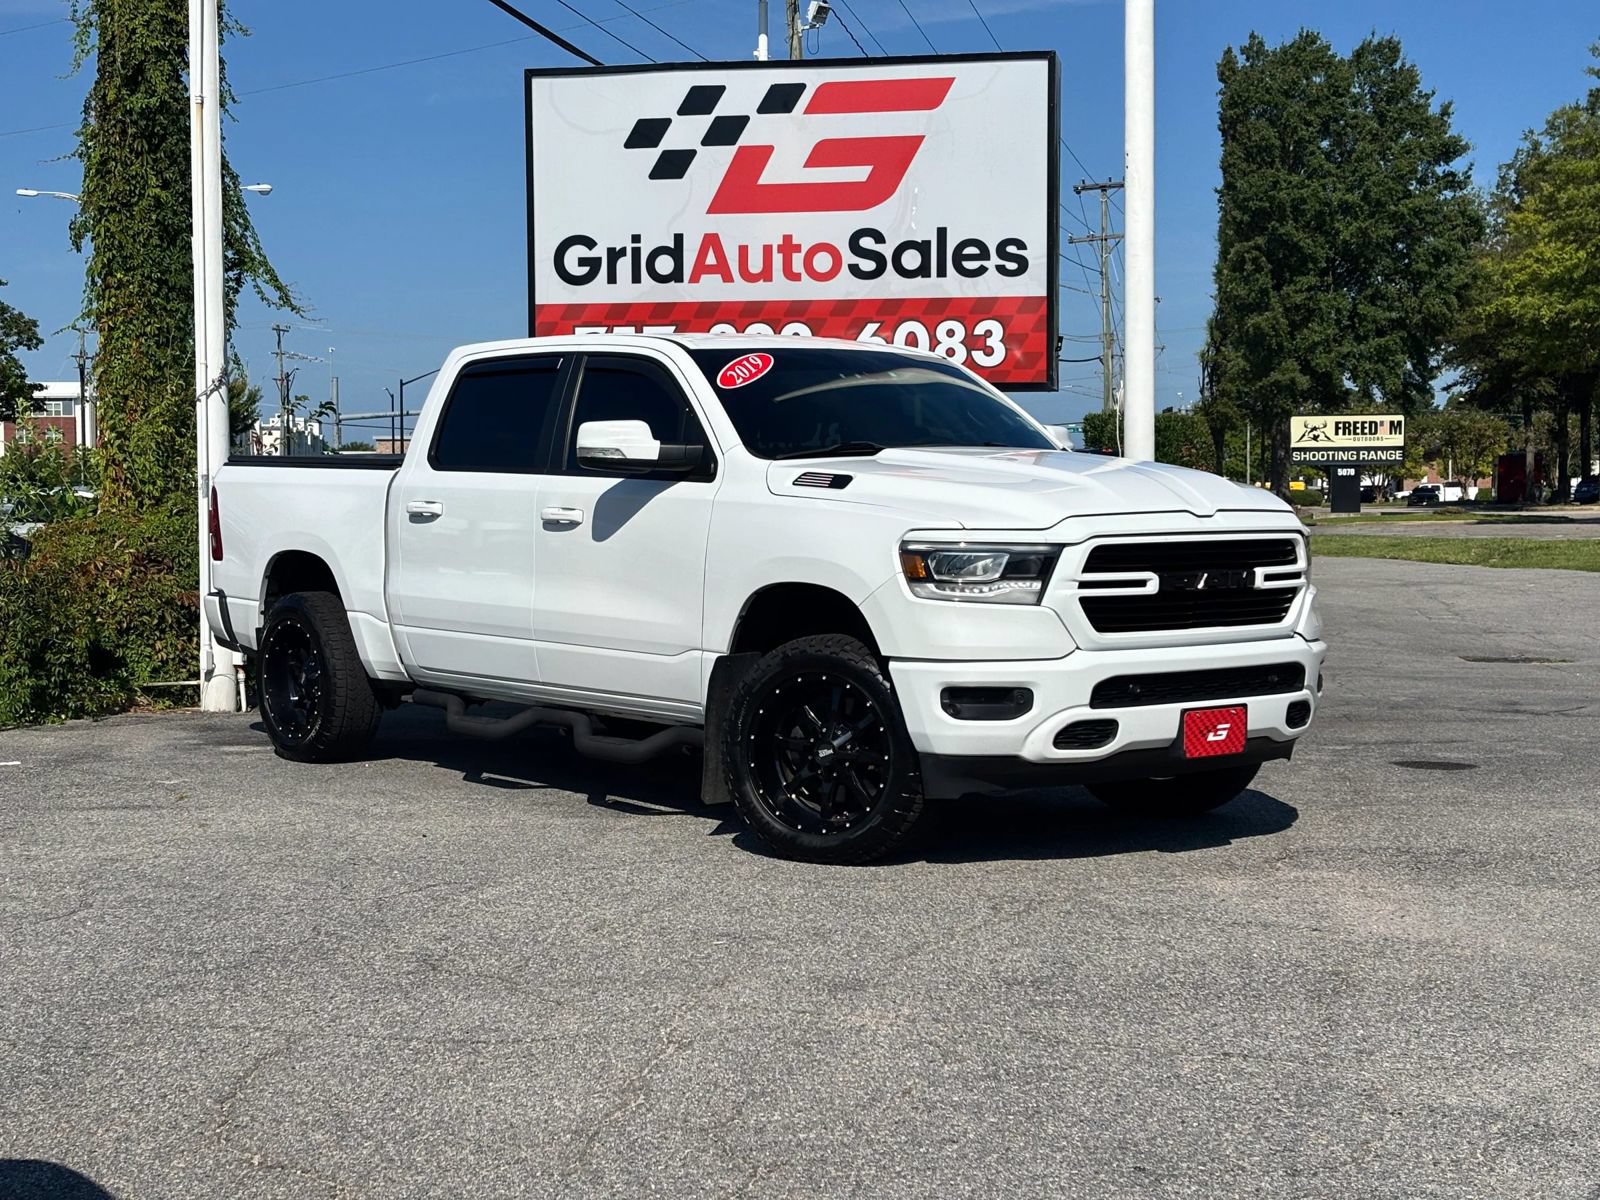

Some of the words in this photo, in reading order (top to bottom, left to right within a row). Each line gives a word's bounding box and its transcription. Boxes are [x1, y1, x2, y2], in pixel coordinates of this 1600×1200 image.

[553, 227, 1029, 287] GridAutoSales
[728, 355, 763, 384] 2019
[1292, 450, 1357, 461] SHOOTING
[1359, 450, 1403, 460] RANGE
[1337, 468, 1355, 476] 5070
